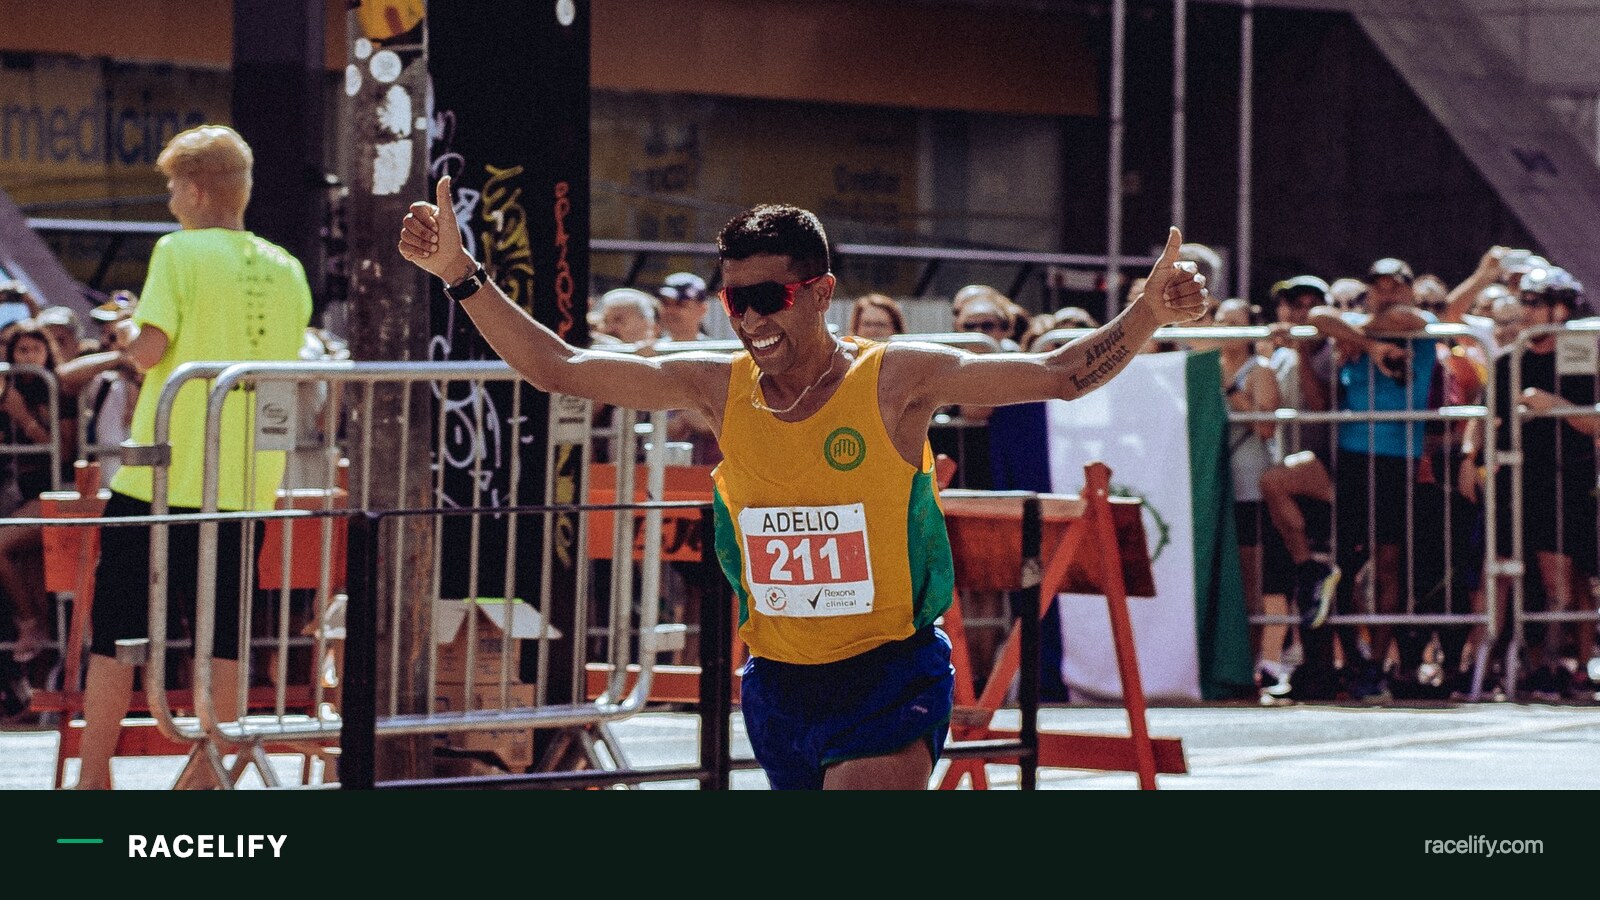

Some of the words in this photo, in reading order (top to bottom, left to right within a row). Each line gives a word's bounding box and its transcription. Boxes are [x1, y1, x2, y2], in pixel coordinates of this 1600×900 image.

[762, 511, 839, 532] ADELIO
[765, 537, 841, 581] 211
[824, 588, 856, 598] Rexona
[825, 599, 857, 608] clinical
